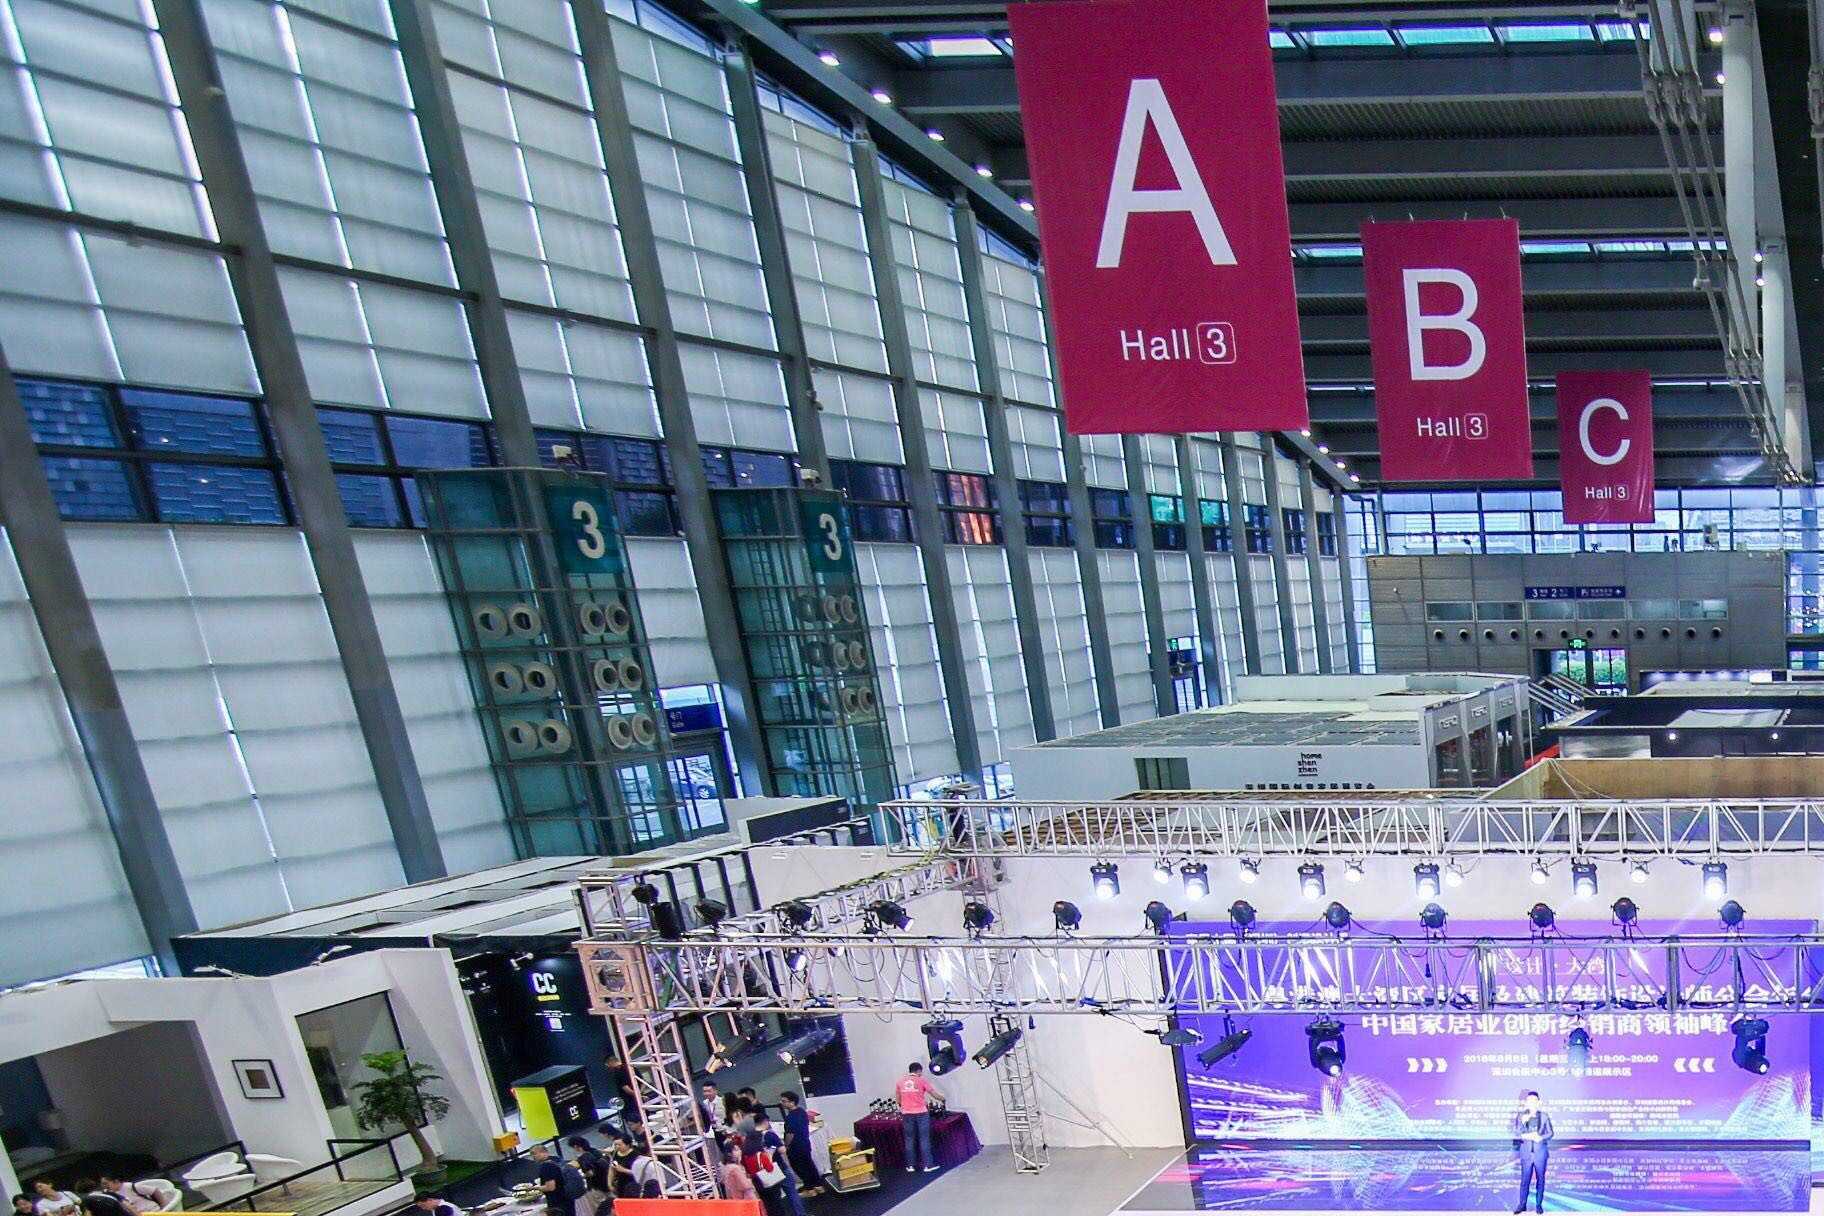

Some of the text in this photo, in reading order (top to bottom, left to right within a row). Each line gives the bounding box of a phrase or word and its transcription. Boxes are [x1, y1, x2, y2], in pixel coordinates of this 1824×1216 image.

[1096, 79, 1237, 268] A
[1121, 330, 1227, 361] Hall 3
[1403, 268, 1486, 380] B
[1417, 417, 1483, 437] Hall 3
[1579, 398, 1630, 465] C
[1585, 486, 1627, 499] Hall 3
[572, 500, 605, 559] 3
[819, 513, 842, 560] 3
